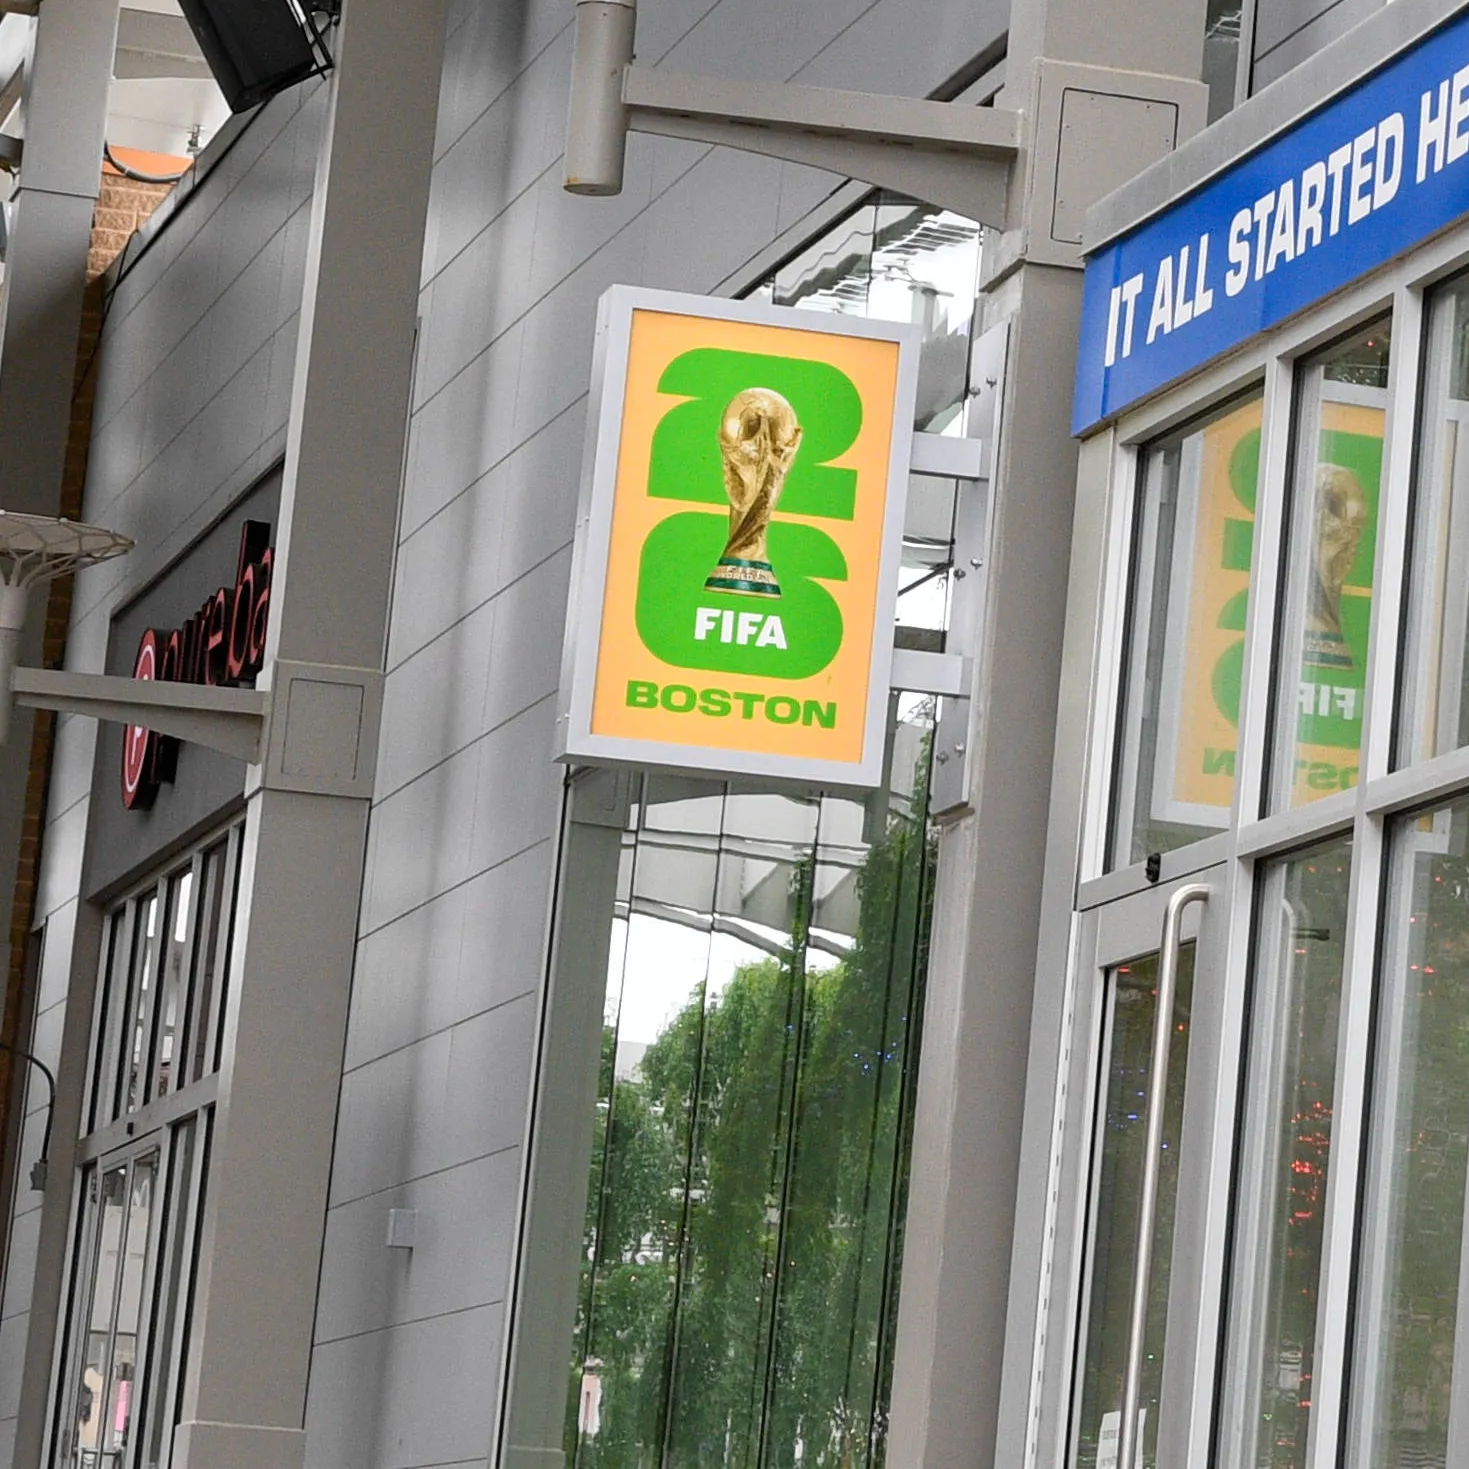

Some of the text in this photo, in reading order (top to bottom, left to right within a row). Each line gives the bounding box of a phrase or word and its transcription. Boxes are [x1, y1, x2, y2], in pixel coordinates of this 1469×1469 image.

[1104, 271, 1143, 367] IT
[1146, 233, 1213, 345] ALL
[1225, 111, 1404, 297] STARTED
[694, 607, 788, 650] FIFA
[625, 679, 837, 729] BOSTON
